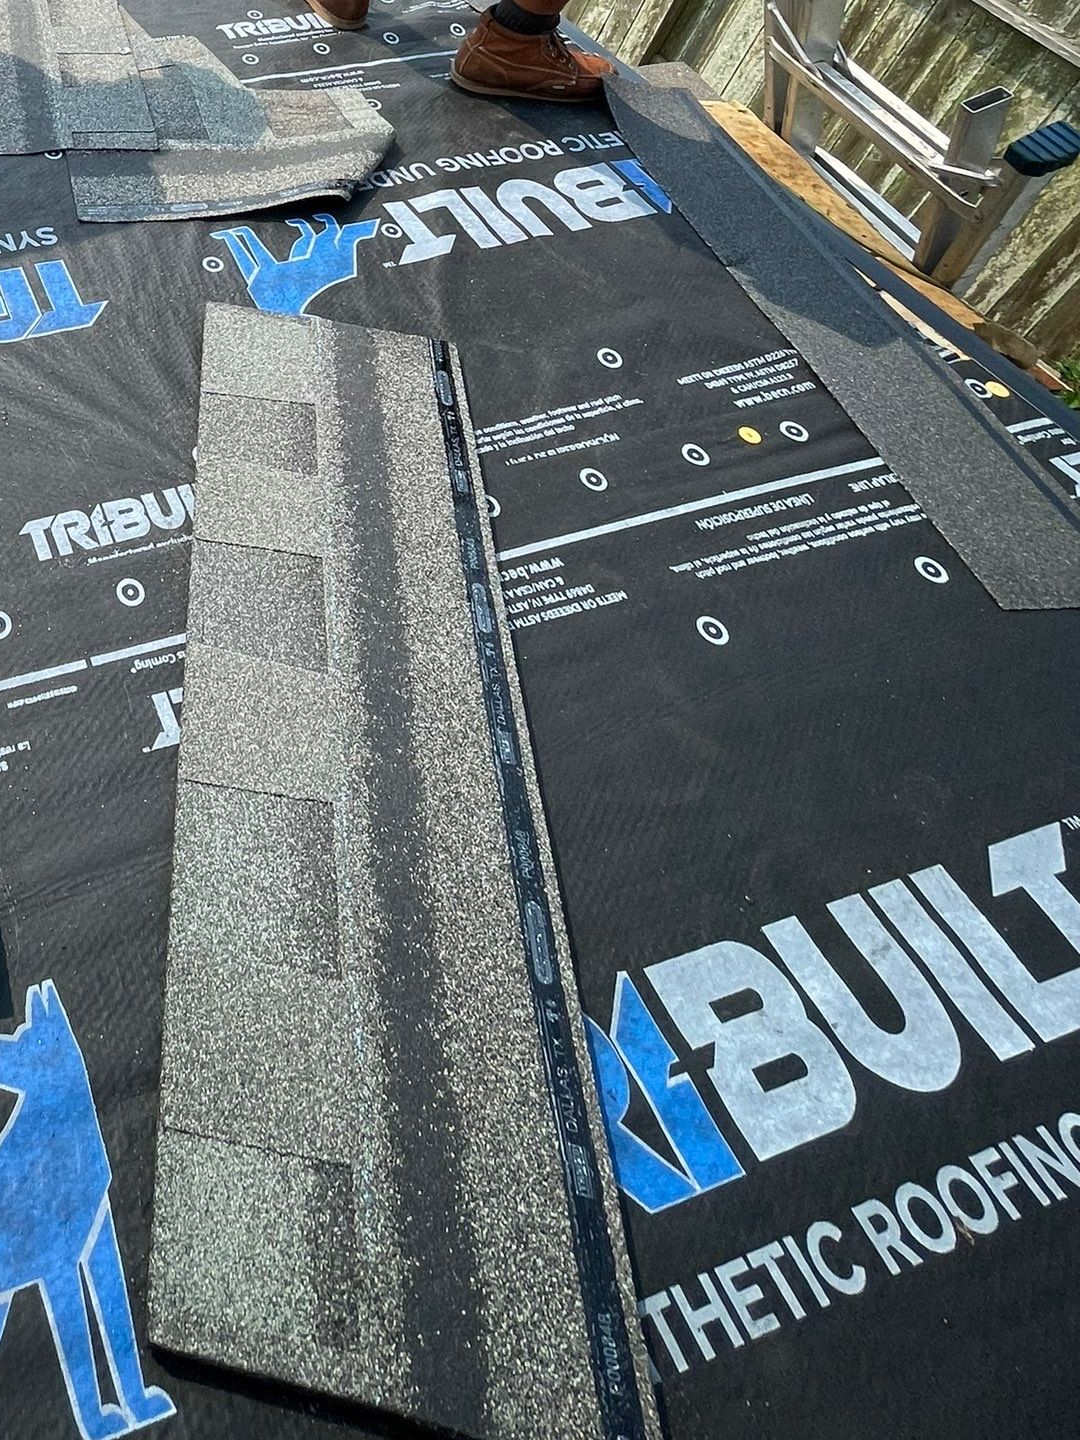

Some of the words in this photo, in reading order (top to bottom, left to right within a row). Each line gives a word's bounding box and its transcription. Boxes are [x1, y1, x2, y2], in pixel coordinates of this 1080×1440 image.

[215, 12, 333, 40] TRIBUIL
[435, 139, 564, 172] ROOFING
[733, 381, 816, 409] www.becn.com
[541, 591, 568, 605] TYPE
[513, 613, 541, 629] ASTM
